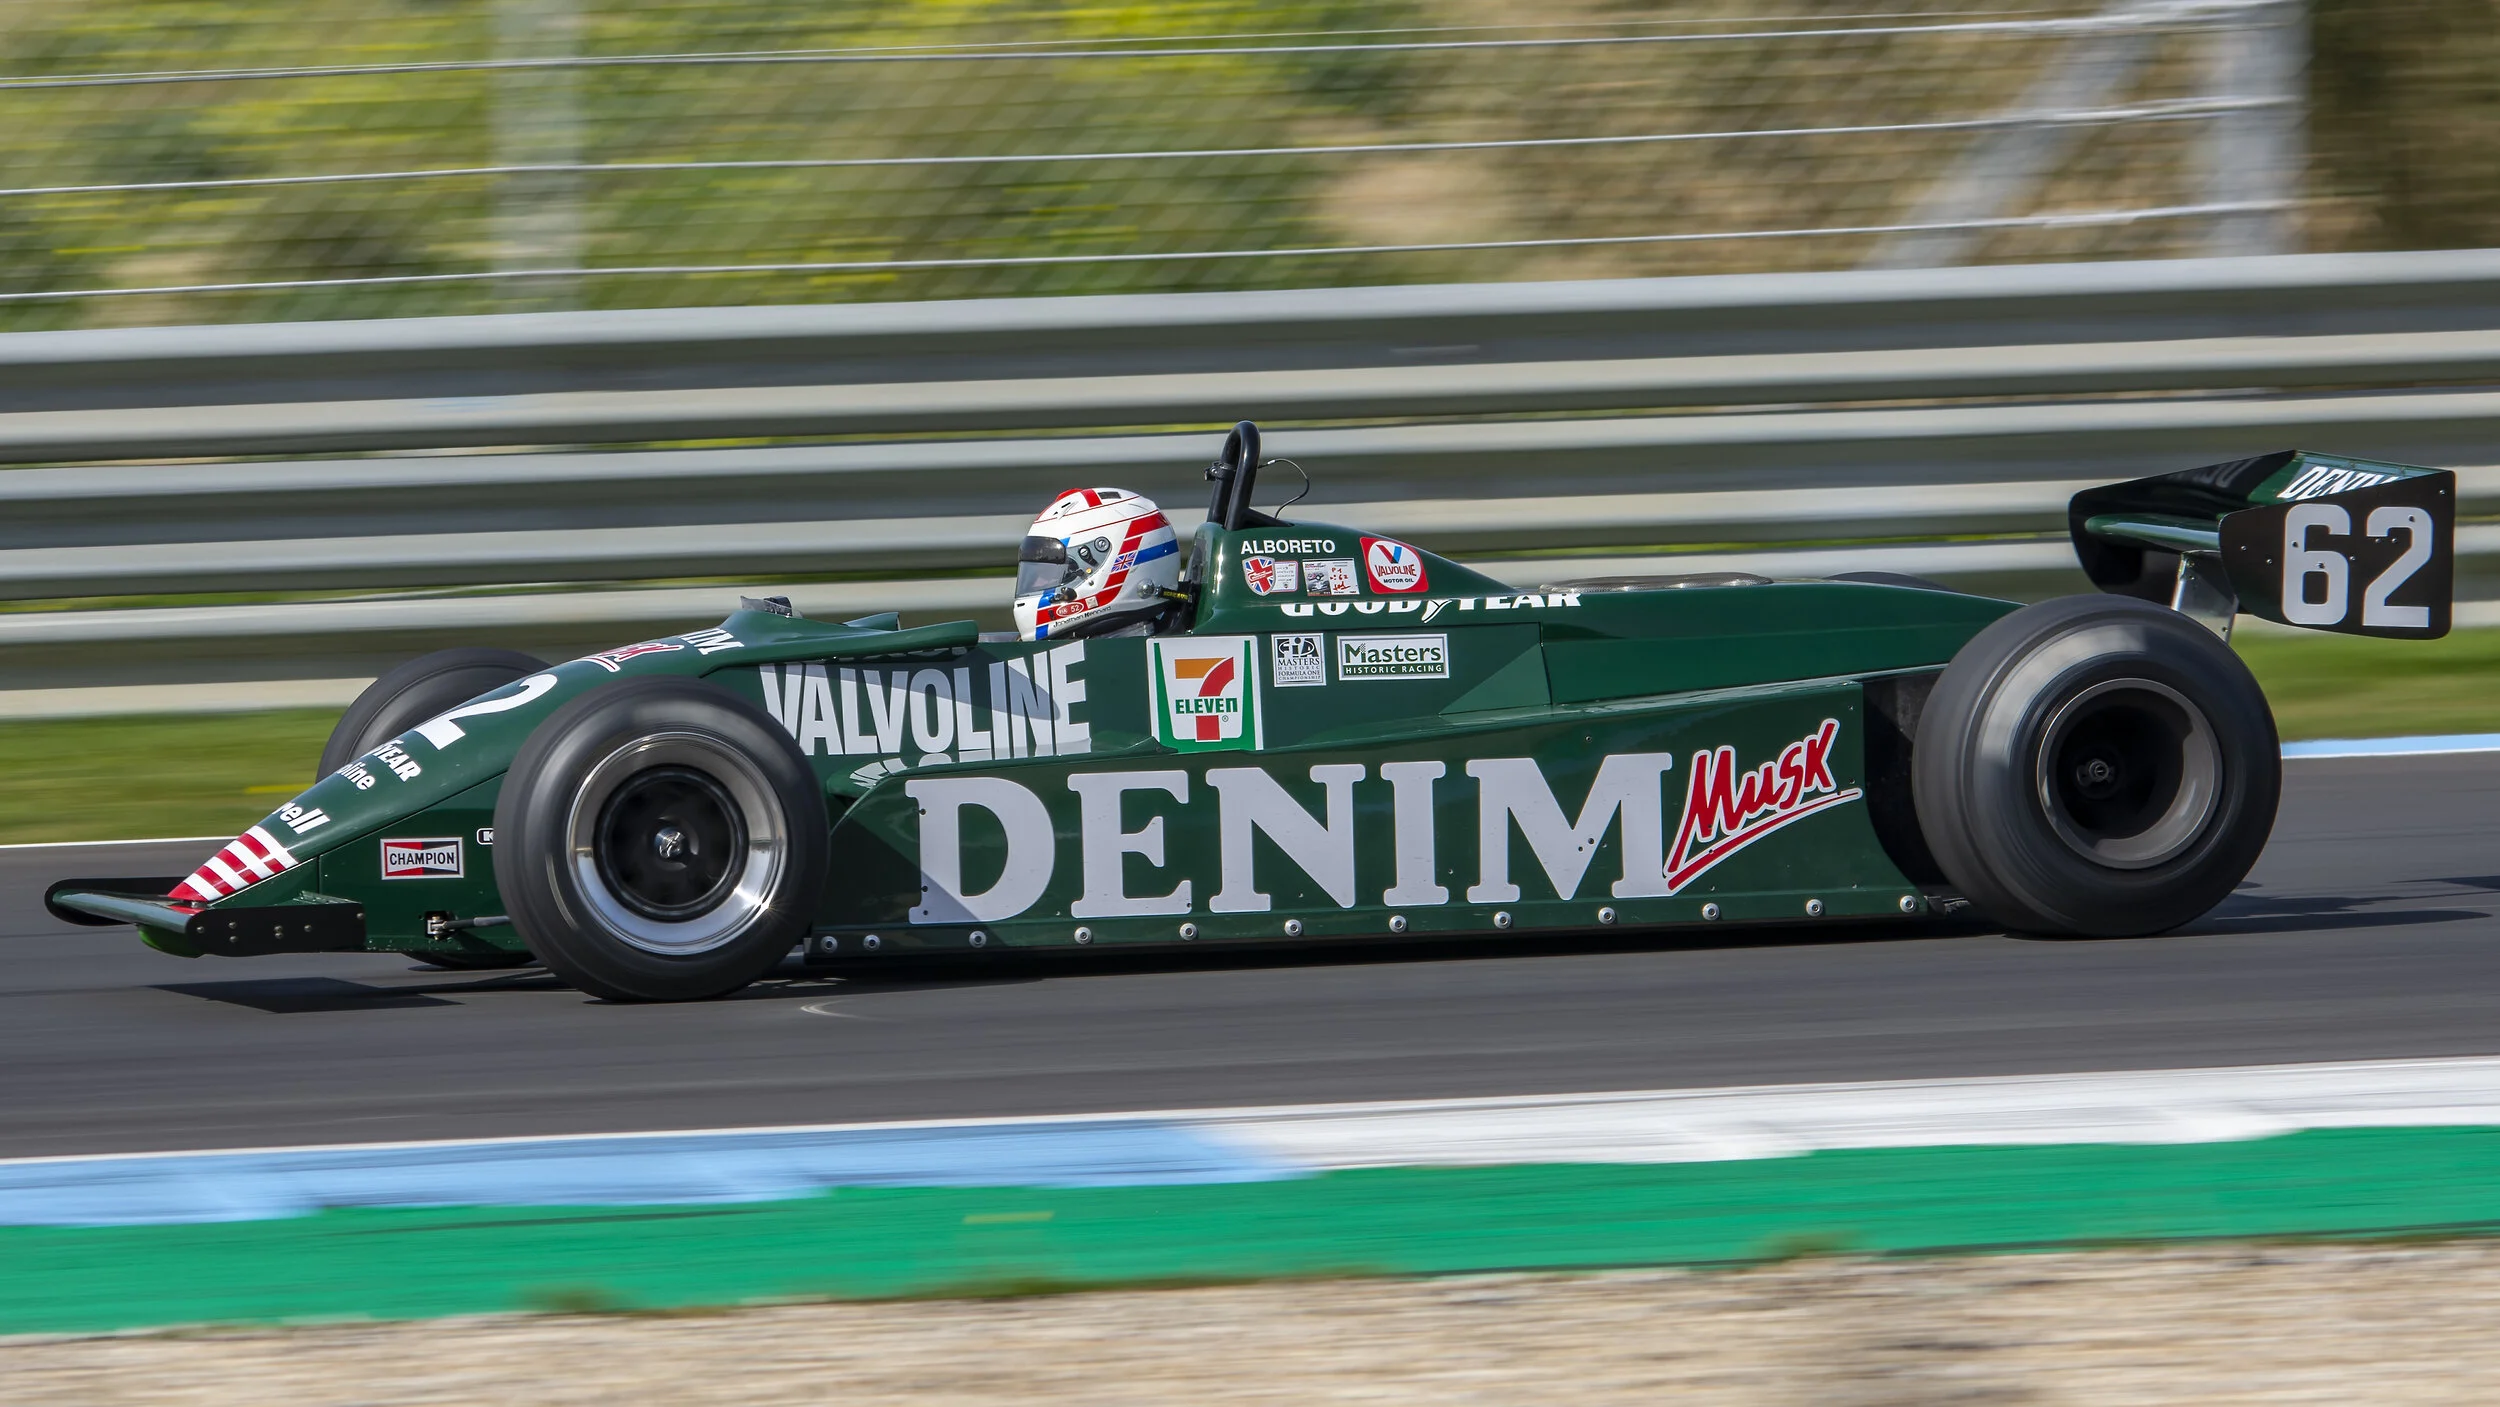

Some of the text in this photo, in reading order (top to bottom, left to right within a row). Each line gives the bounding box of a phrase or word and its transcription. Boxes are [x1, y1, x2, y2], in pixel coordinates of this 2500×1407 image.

[1240, 539, 1336, 555] ALBORETO
[1374, 564, 1417, 578] VALVOLINE
[2281, 503, 2434, 628] 62
[1344, 643, 1442, 663] Masters
[1278, 658, 1320, 667] MASTERS
[1345, 665, 1442, 674] HISTORIC RACING
[759, 639, 1091, 758] VALVOLINE
[904, 752, 1673, 925] DENIM
[389, 852, 455, 866] CHAMPION
